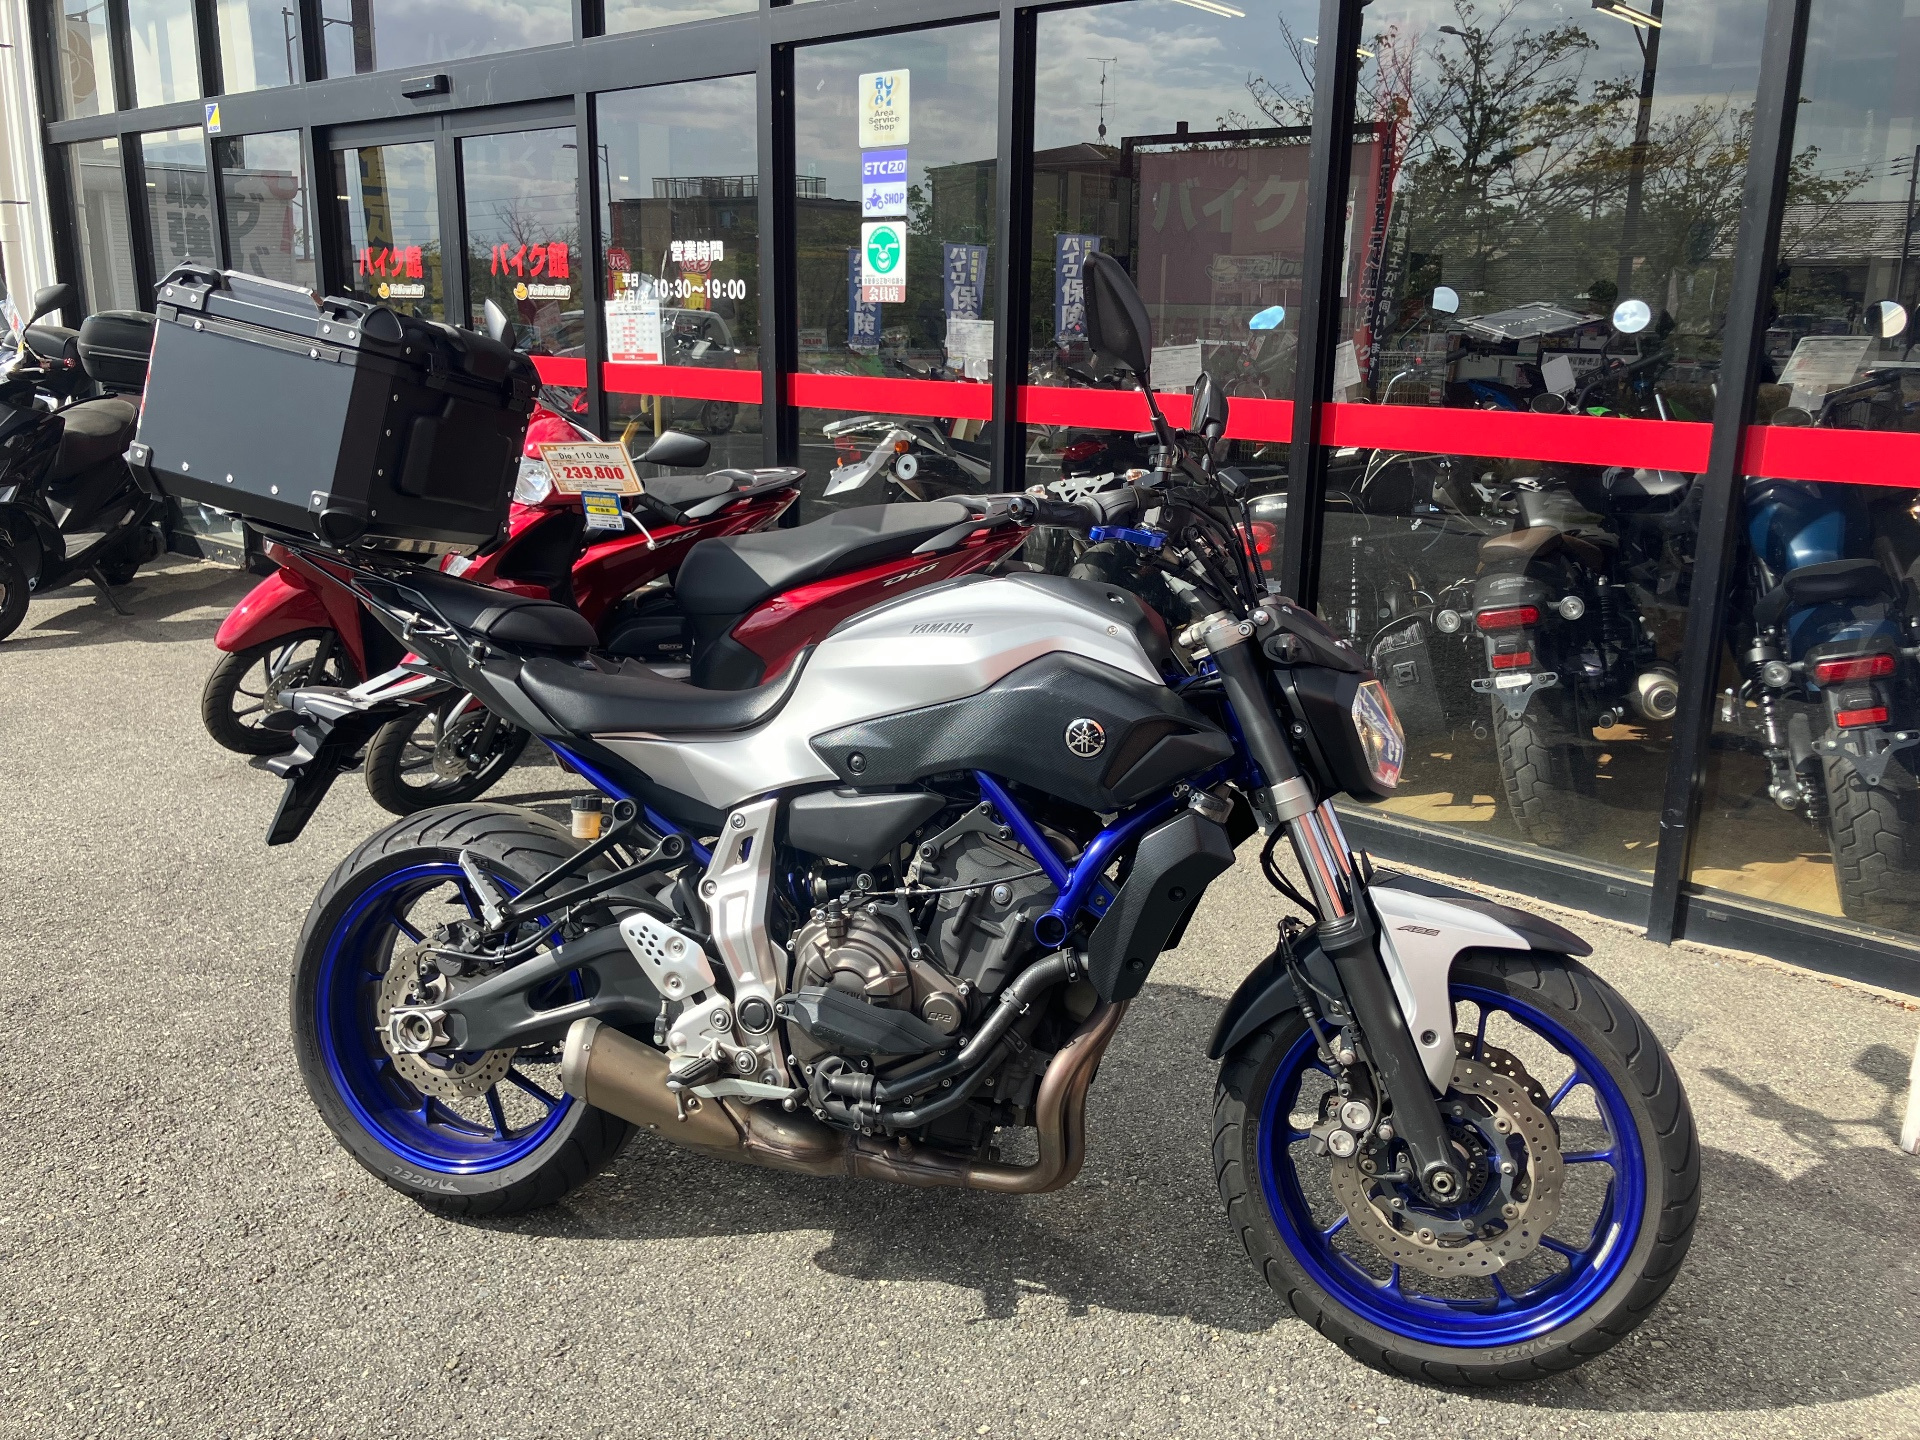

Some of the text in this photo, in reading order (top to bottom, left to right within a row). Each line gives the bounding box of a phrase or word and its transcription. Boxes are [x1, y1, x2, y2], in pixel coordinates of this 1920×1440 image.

[868, 116, 900, 125] Service
[874, 123, 895, 131] Shop
[864, 161, 904, 176] ETC 2.0
[884, 193, 905, 205] SHOP
[1152, 173, 1311, 234] バイク
[670, 240, 724, 261] 営業時間
[359, 245, 423, 278] バイク館
[490, 241, 569, 278] バイク館
[622, 273, 639, 287] 平日
[868, 286, 899, 302] 会員店
[558, 452, 610, 460] Dio 110 Lite
[562, 466, 625, 480] 239,800
[1256, 502, 1288, 513] Kawasa
[909, 622, 974, 635] YAMAHA
[394, 1165, 462, 1193] ANGEL
